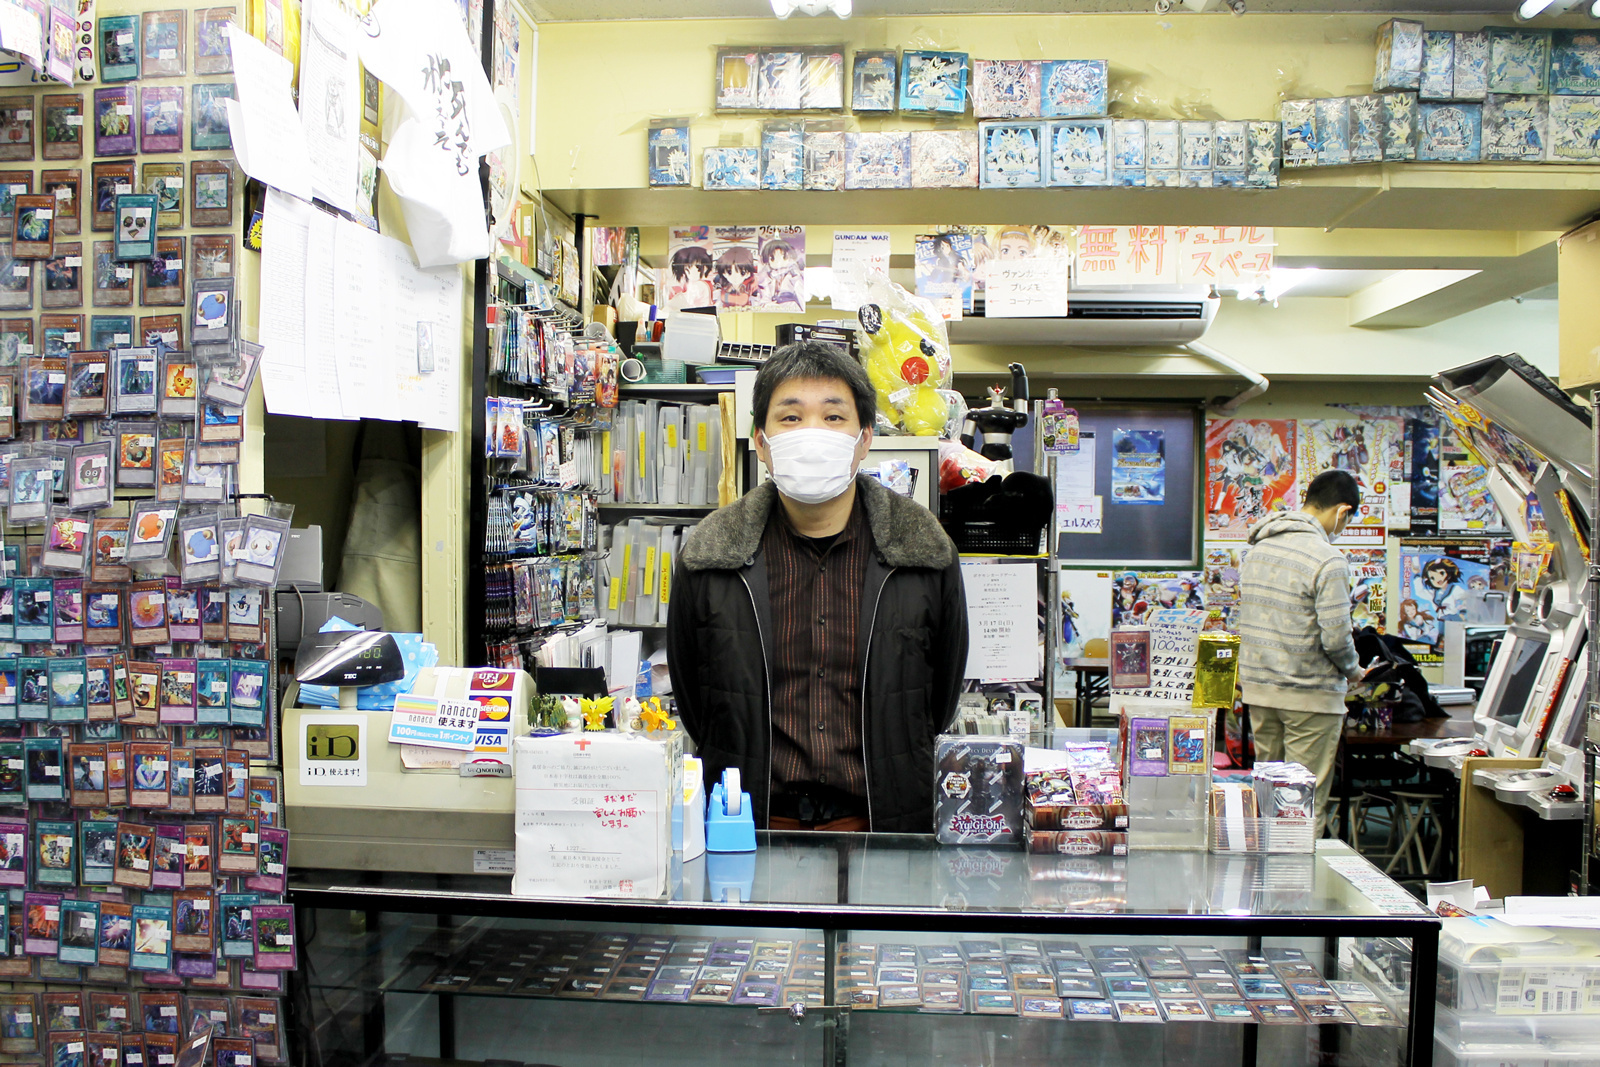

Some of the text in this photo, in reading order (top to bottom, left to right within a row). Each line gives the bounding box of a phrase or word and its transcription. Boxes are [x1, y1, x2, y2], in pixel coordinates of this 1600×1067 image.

[1079, 225, 1168, 277] 無料
[1192, 250, 1272, 278] スペース
[1009, 297, 1043, 305] コーナー
[1369, 583, 1383, 613] 光臨
[479, 672, 499, 680] UFJ
[440, 704, 478, 719] nanaco
[480, 704, 508, 712] sterCard
[408, 714, 433, 724] nanaco
[438, 716, 476, 730] 使えます
[475, 735, 502, 745] VISA
[309, 735, 357, 759] iD
[307, 767, 326, 776] iD
[571, 797, 594, 805] 受領証
[603, 792, 637, 803] まだまだ
